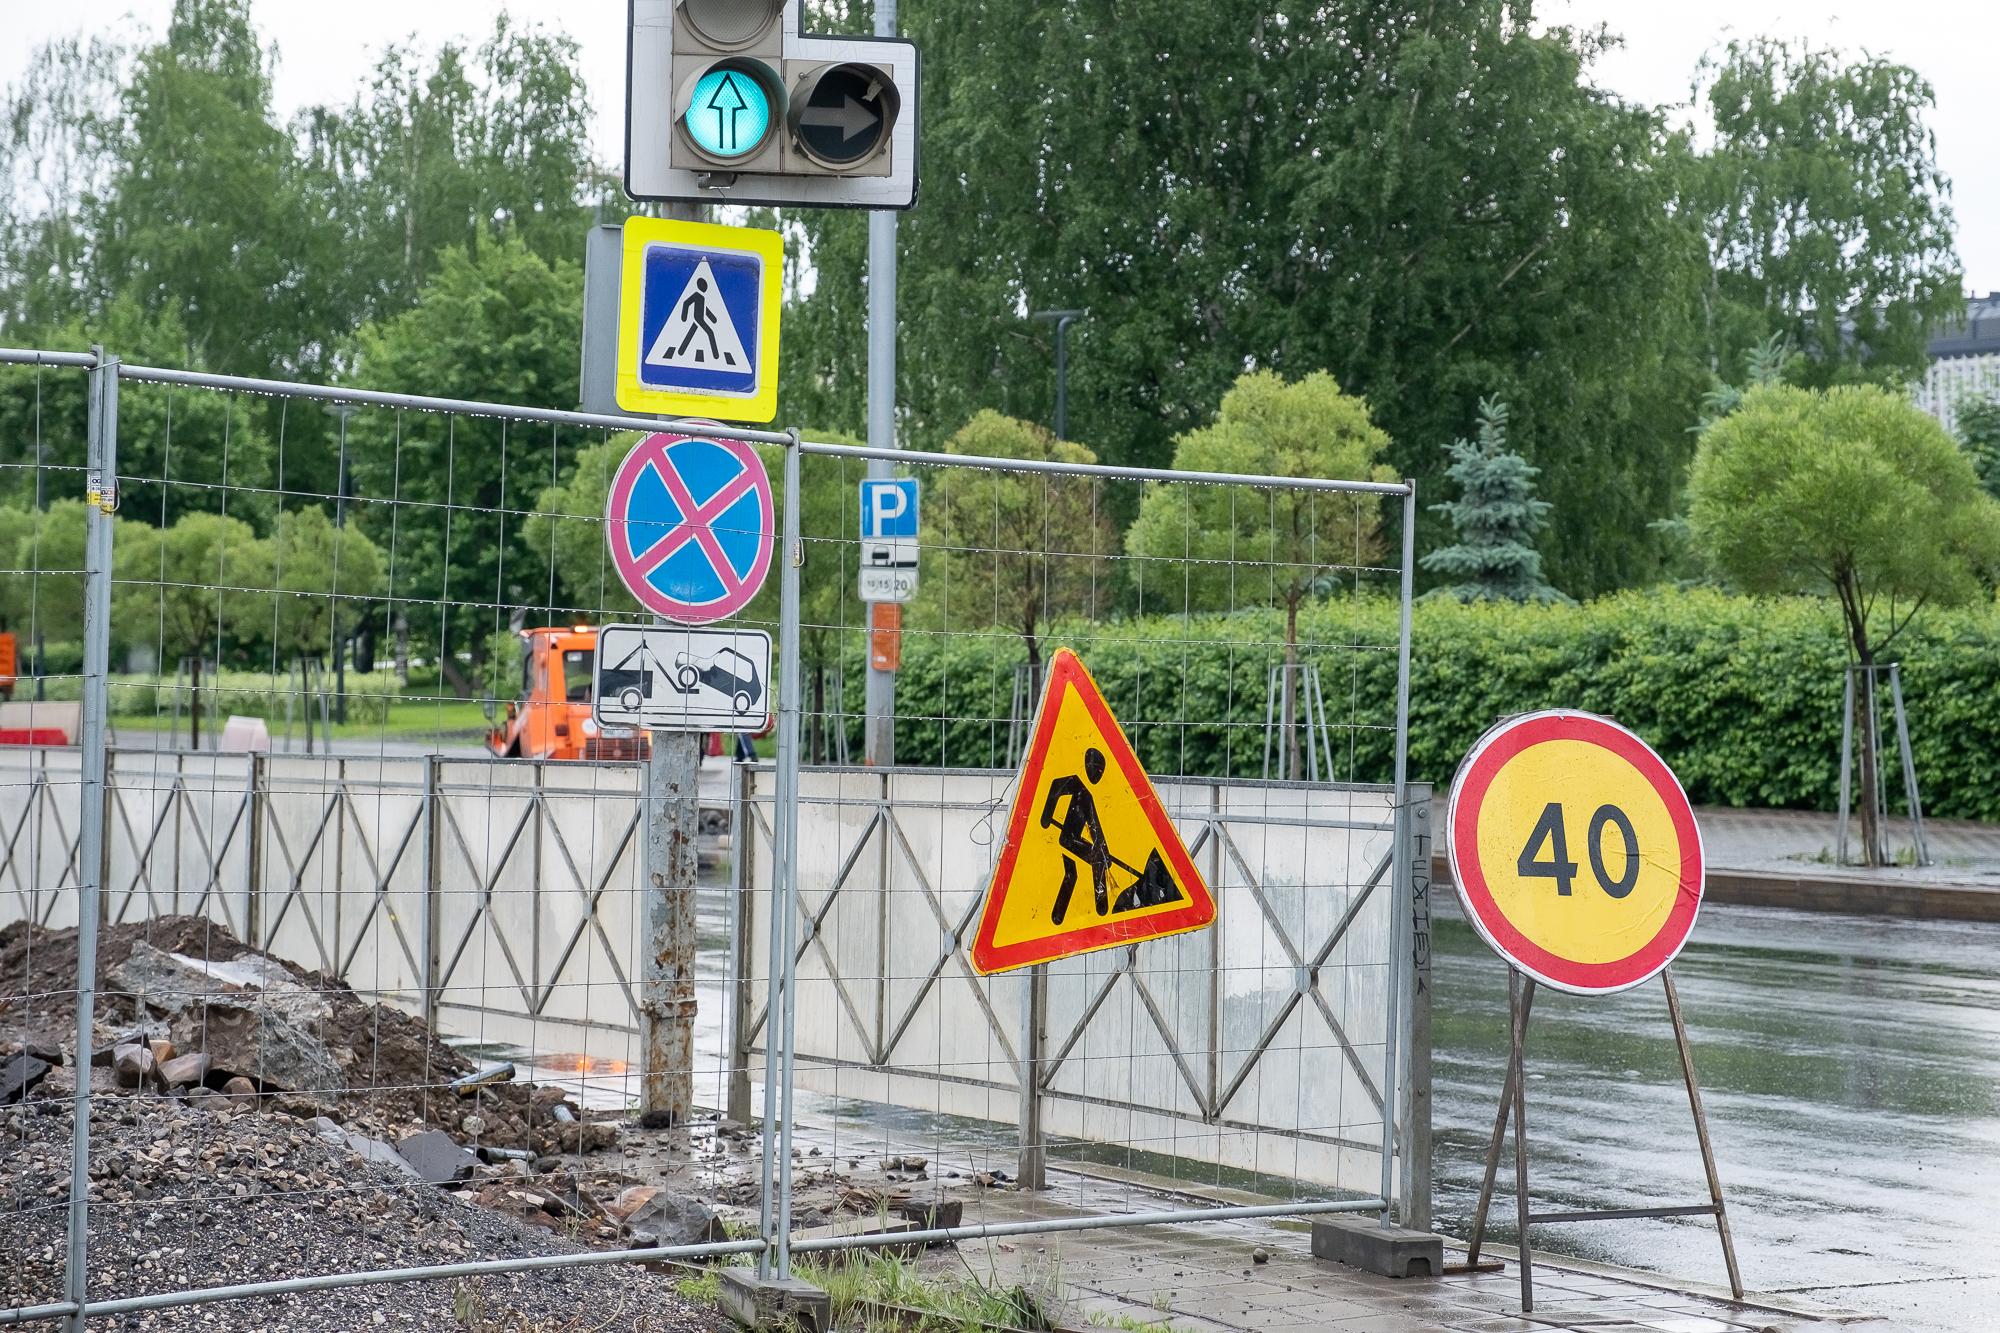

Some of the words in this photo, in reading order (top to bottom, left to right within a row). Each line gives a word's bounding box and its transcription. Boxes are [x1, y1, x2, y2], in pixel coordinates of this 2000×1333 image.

[872, 484, 907, 537] P
[894, 579, 908, 591] 20
[1517, 802, 1640, 898] 40
